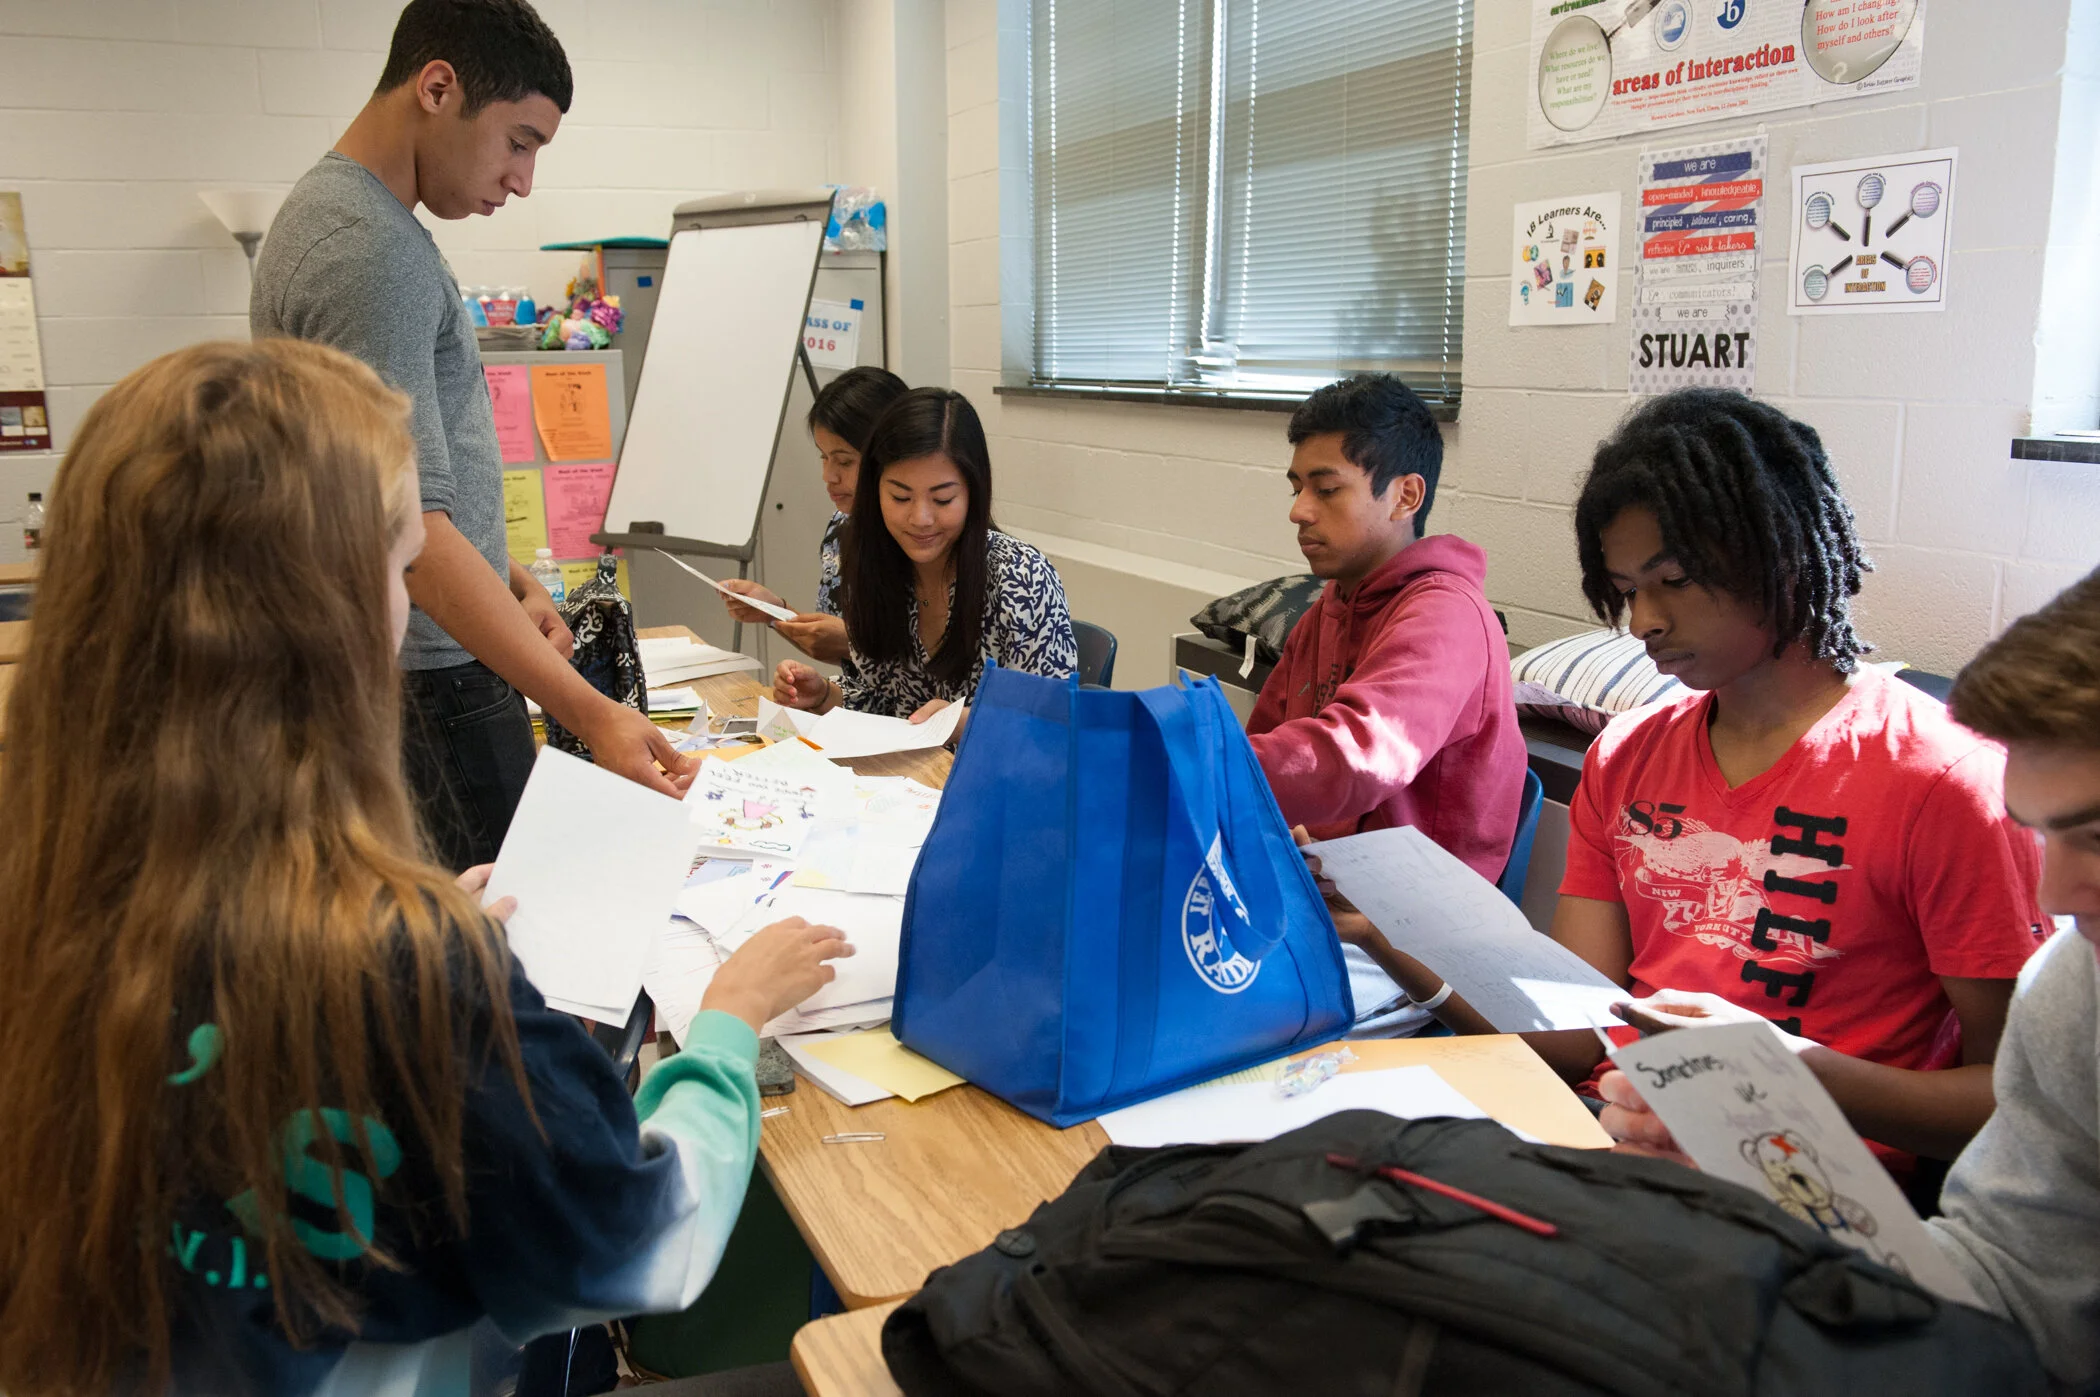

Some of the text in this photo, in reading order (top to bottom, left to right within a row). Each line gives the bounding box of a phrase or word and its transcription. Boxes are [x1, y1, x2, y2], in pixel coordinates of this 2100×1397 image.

[1816, 10, 1835, 21] How
[1838, 8, 1850, 16] am
[1852, 3, 1856, 13] I
[1816, 10, 1900, 36] How do I look after
[1817, 24, 1895, 51] myself and others?
[1612, 72, 1660, 96] areas
[1665, 62, 1685, 86] of
[1687, 43, 1796, 82] interaction
[1684, 159, 1716, 172] we are
[1526, 221, 1537, 238] IB
[1538, 206, 1581, 225] Learners
[1856, 254, 1877, 280] AREAS OF
[1668, 286, 1736, 300] communicators!
[1844, 281, 1887, 294] INTERACTION
[1676, 308, 1708, 318] we are
[806, 316, 852, 332] ASS OF
[802, 336, 836, 351] 016
[1638, 332, 1750, 368] STUART
[1652, 886, 1682, 898] NEW
[1694, 922, 1722, 933] YORK
[1741, 806, 1848, 1036] HILF
